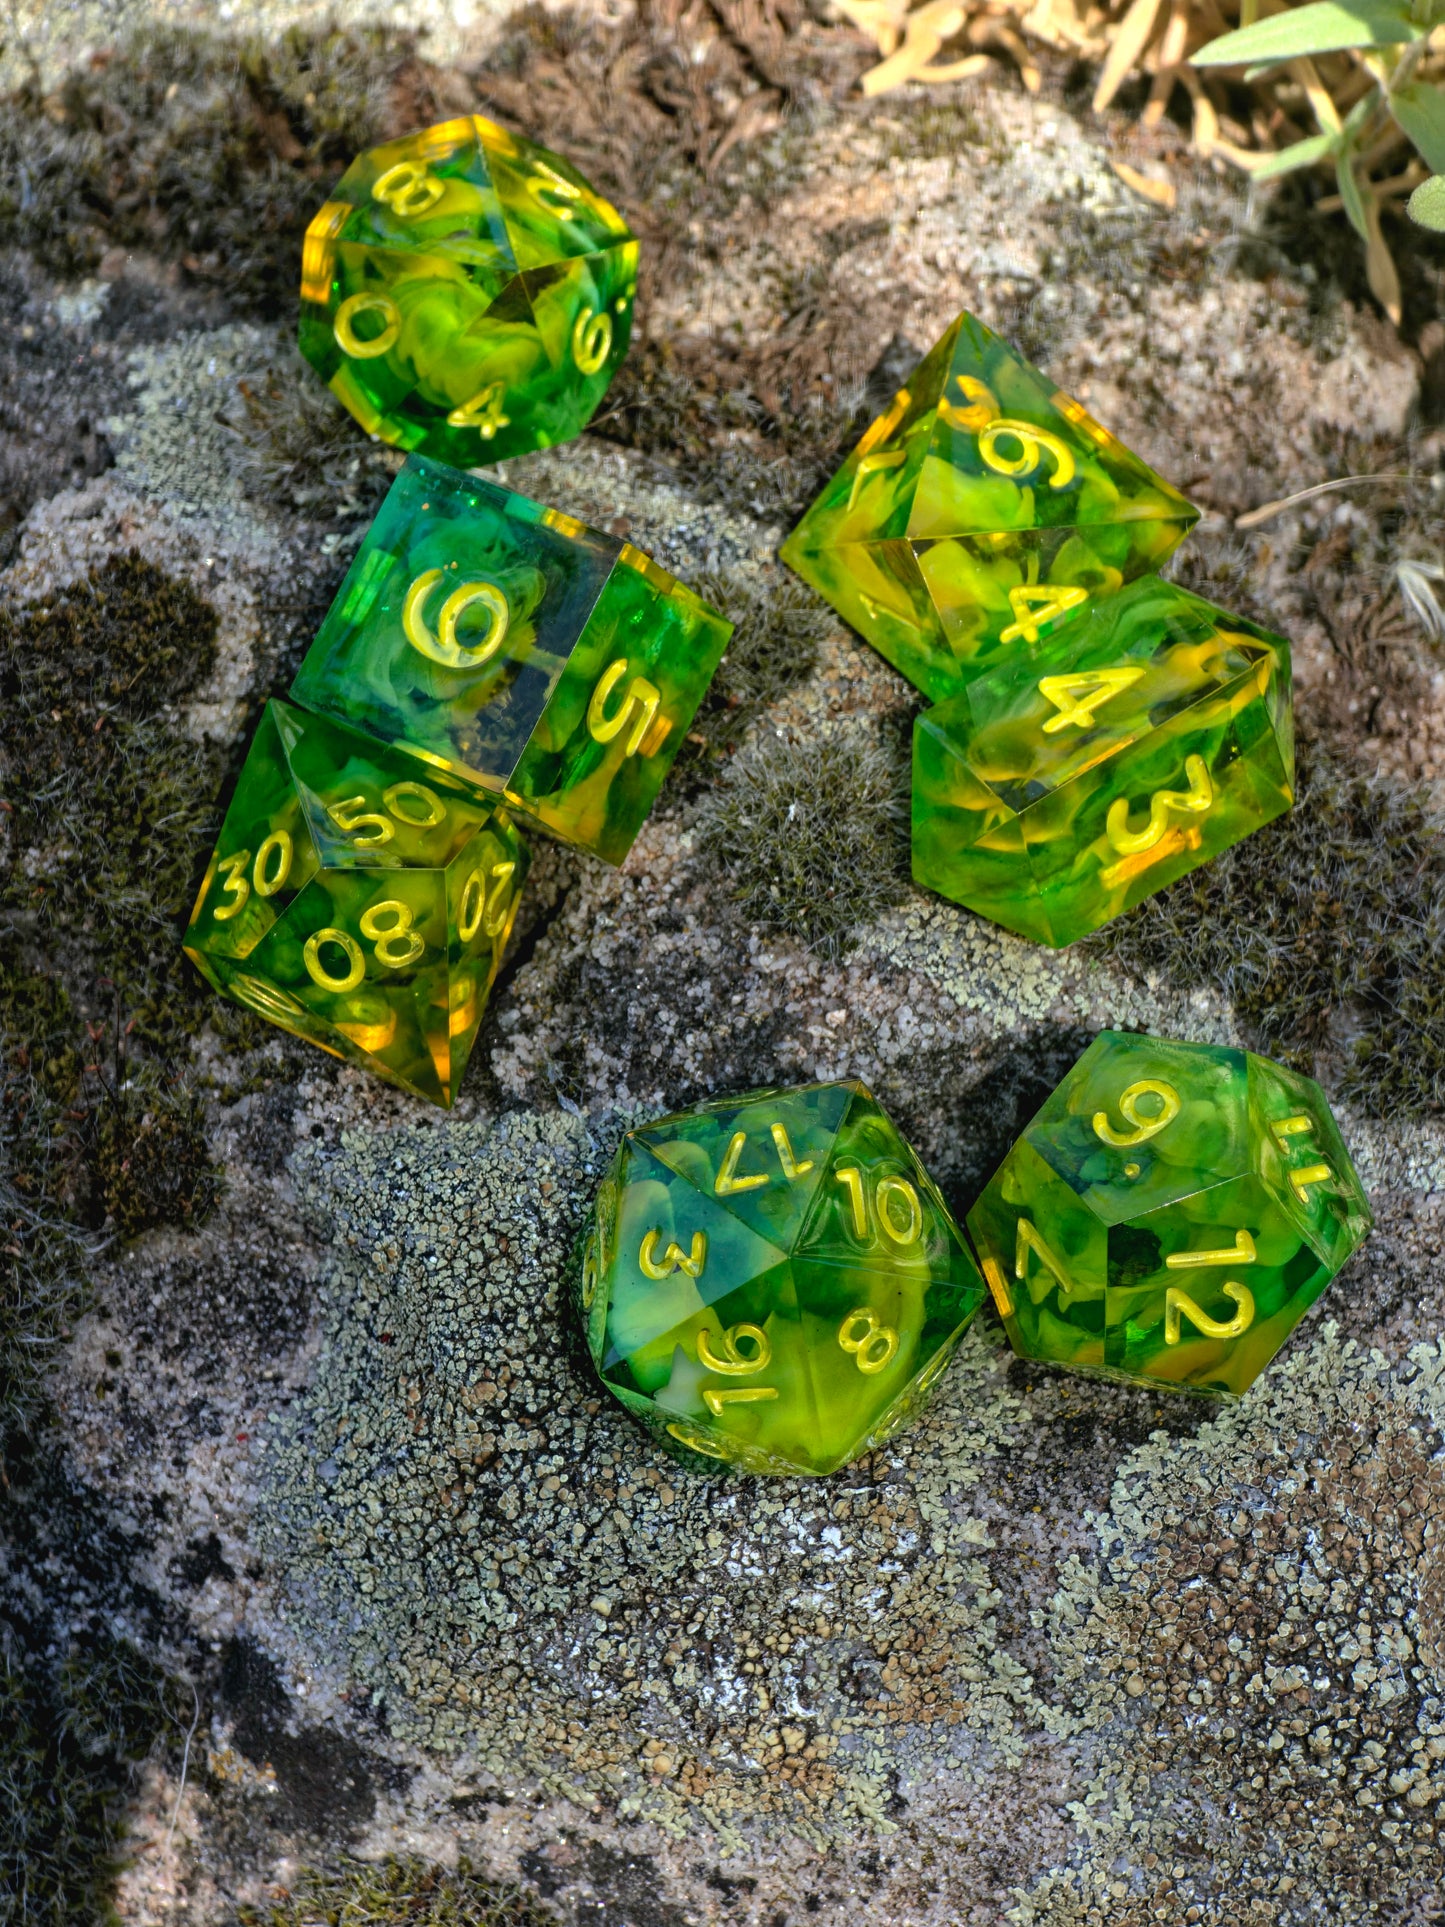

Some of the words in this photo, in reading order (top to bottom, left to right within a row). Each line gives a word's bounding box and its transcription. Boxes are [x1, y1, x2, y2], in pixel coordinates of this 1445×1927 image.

[372, 161, 445, 216] 8
[334, 292, 401, 359] 0
[447, 381, 511, 440] 4
[402, 568, 509, 669] 6
[999, 585, 1089, 643] 4
[586, 658, 660, 757] 5
[1039, 666, 1146, 733] 4
[327, 781, 447, 848] 50
[1106, 754, 1213, 854] 3
[213, 829, 294, 921] 30
[458, 862, 516, 943] 20
[714, 1122, 814, 1197] 17
[1270, 1115, 1333, 1203] 11
[836, 1167, 924, 1246] 10
[639, 1229, 708, 1280] 3
[1015, 1217, 1074, 1294] 7
[1165, 1229, 1257, 1345] 12
[696, 1322, 779, 1417] 16
[837, 1306, 899, 1375] 8
